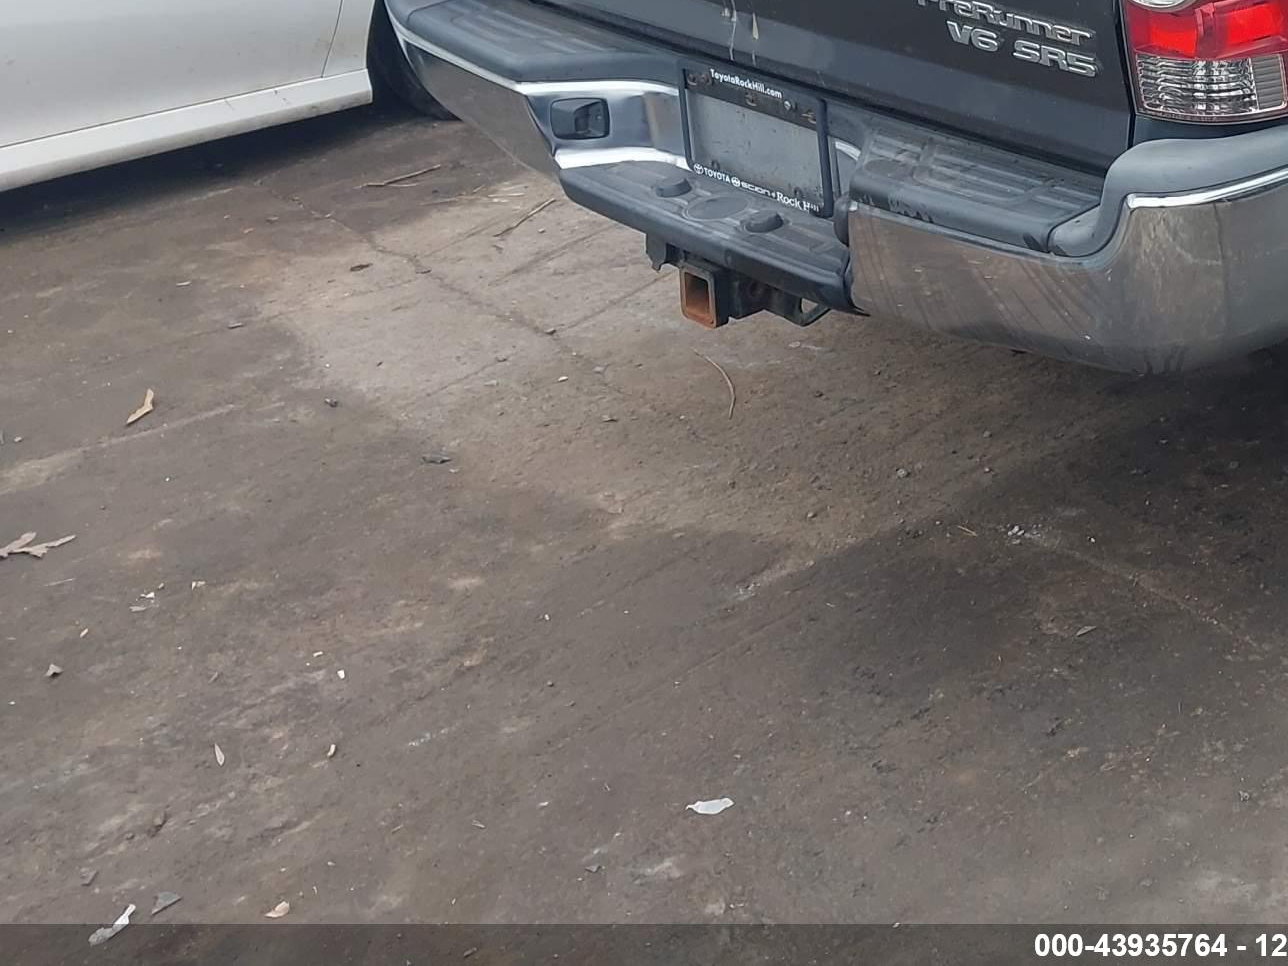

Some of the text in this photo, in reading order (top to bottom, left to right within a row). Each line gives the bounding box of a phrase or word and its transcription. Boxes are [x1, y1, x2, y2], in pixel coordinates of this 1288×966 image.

[946, 20, 1098, 78] V6 SR5
[710, 68, 782, 99] ToyotaRockHill.com
[704, 168, 731, 184] TOYOTA
